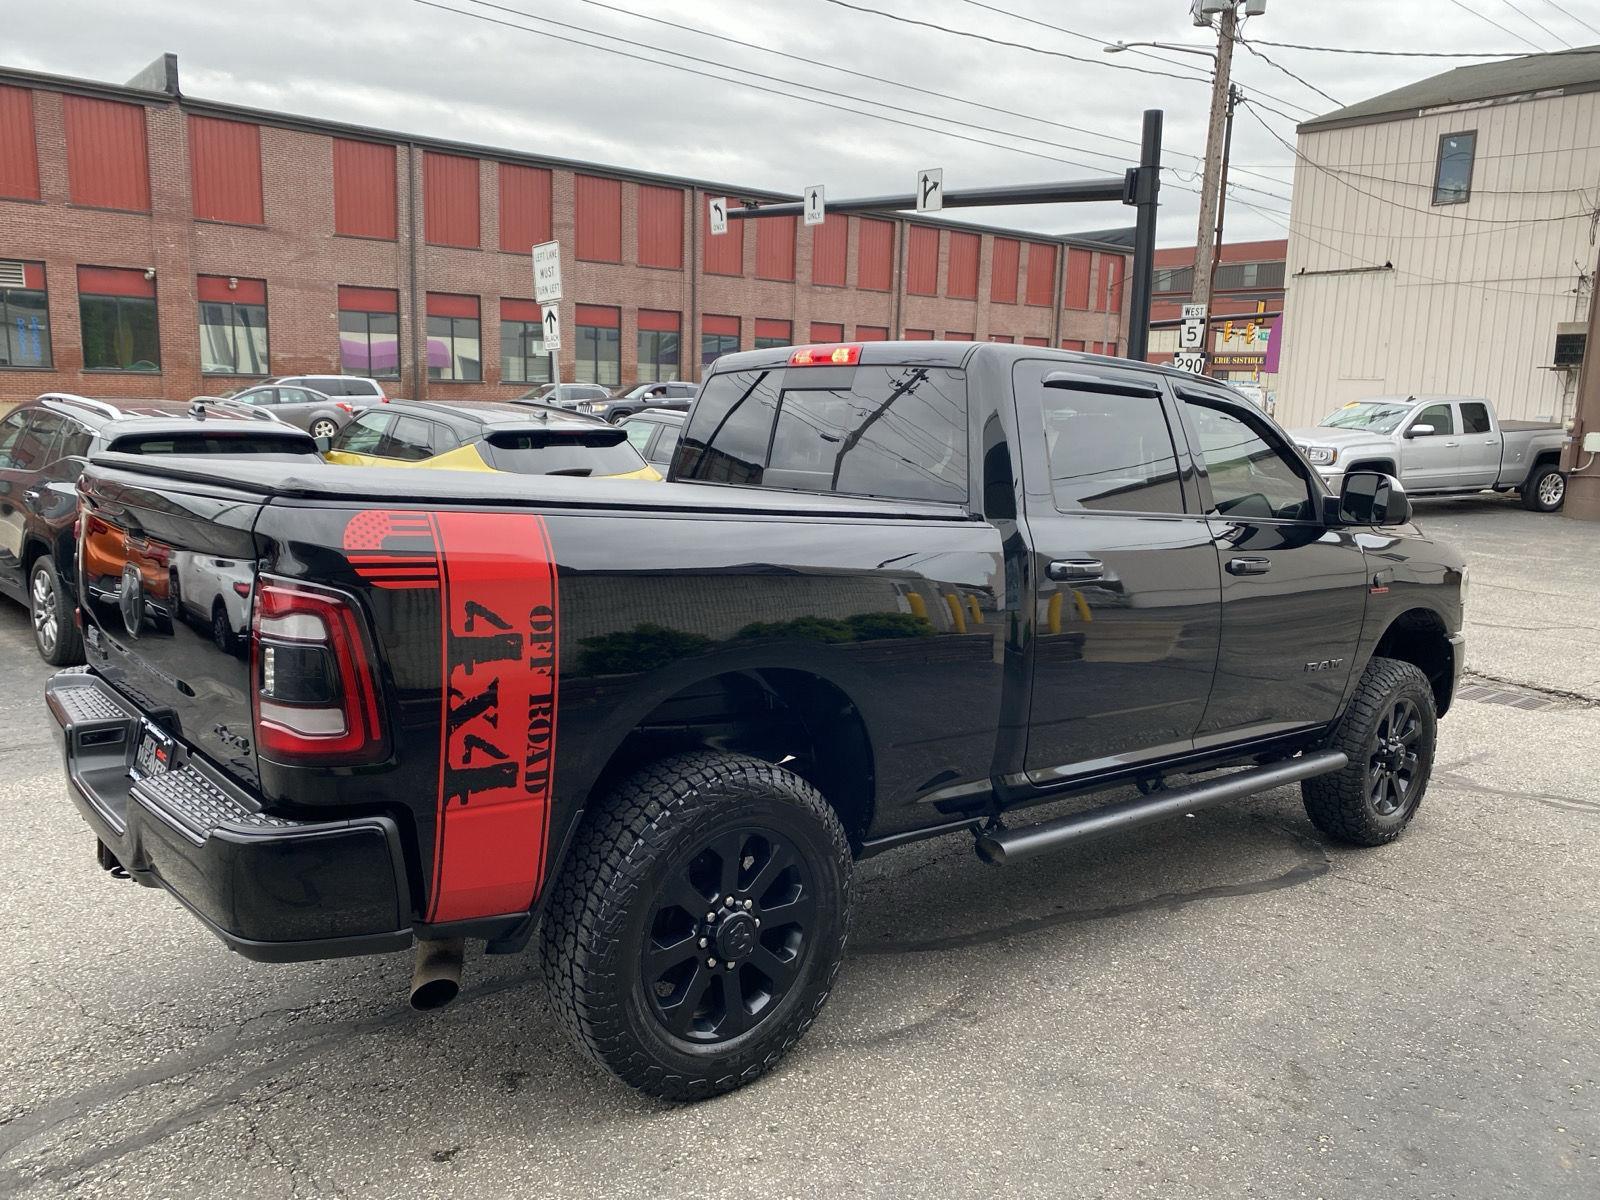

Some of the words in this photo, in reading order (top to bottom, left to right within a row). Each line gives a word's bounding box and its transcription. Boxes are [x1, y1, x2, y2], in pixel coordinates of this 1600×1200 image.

[808, 211, 821, 220] ONLY
[713, 223, 724, 231] ONLY
[536, 251, 546, 262] LEFT
[547, 249, 558, 260] LANE
[540, 266, 554, 279] MUST
[537, 285, 548, 296] TURN
[549, 283, 560, 294] LEFT
[1185, 307, 1204, 316] WEST
[1187, 326, 1197, 342] 5
[1177, 358, 1202, 374] 290
[1214, 356, 1230, 364] ERIE
[1232, 356, 1264, 364] SISTIBLE
[529, 605, 553, 677] OFF
[525, 693, 553, 794] ROAD
